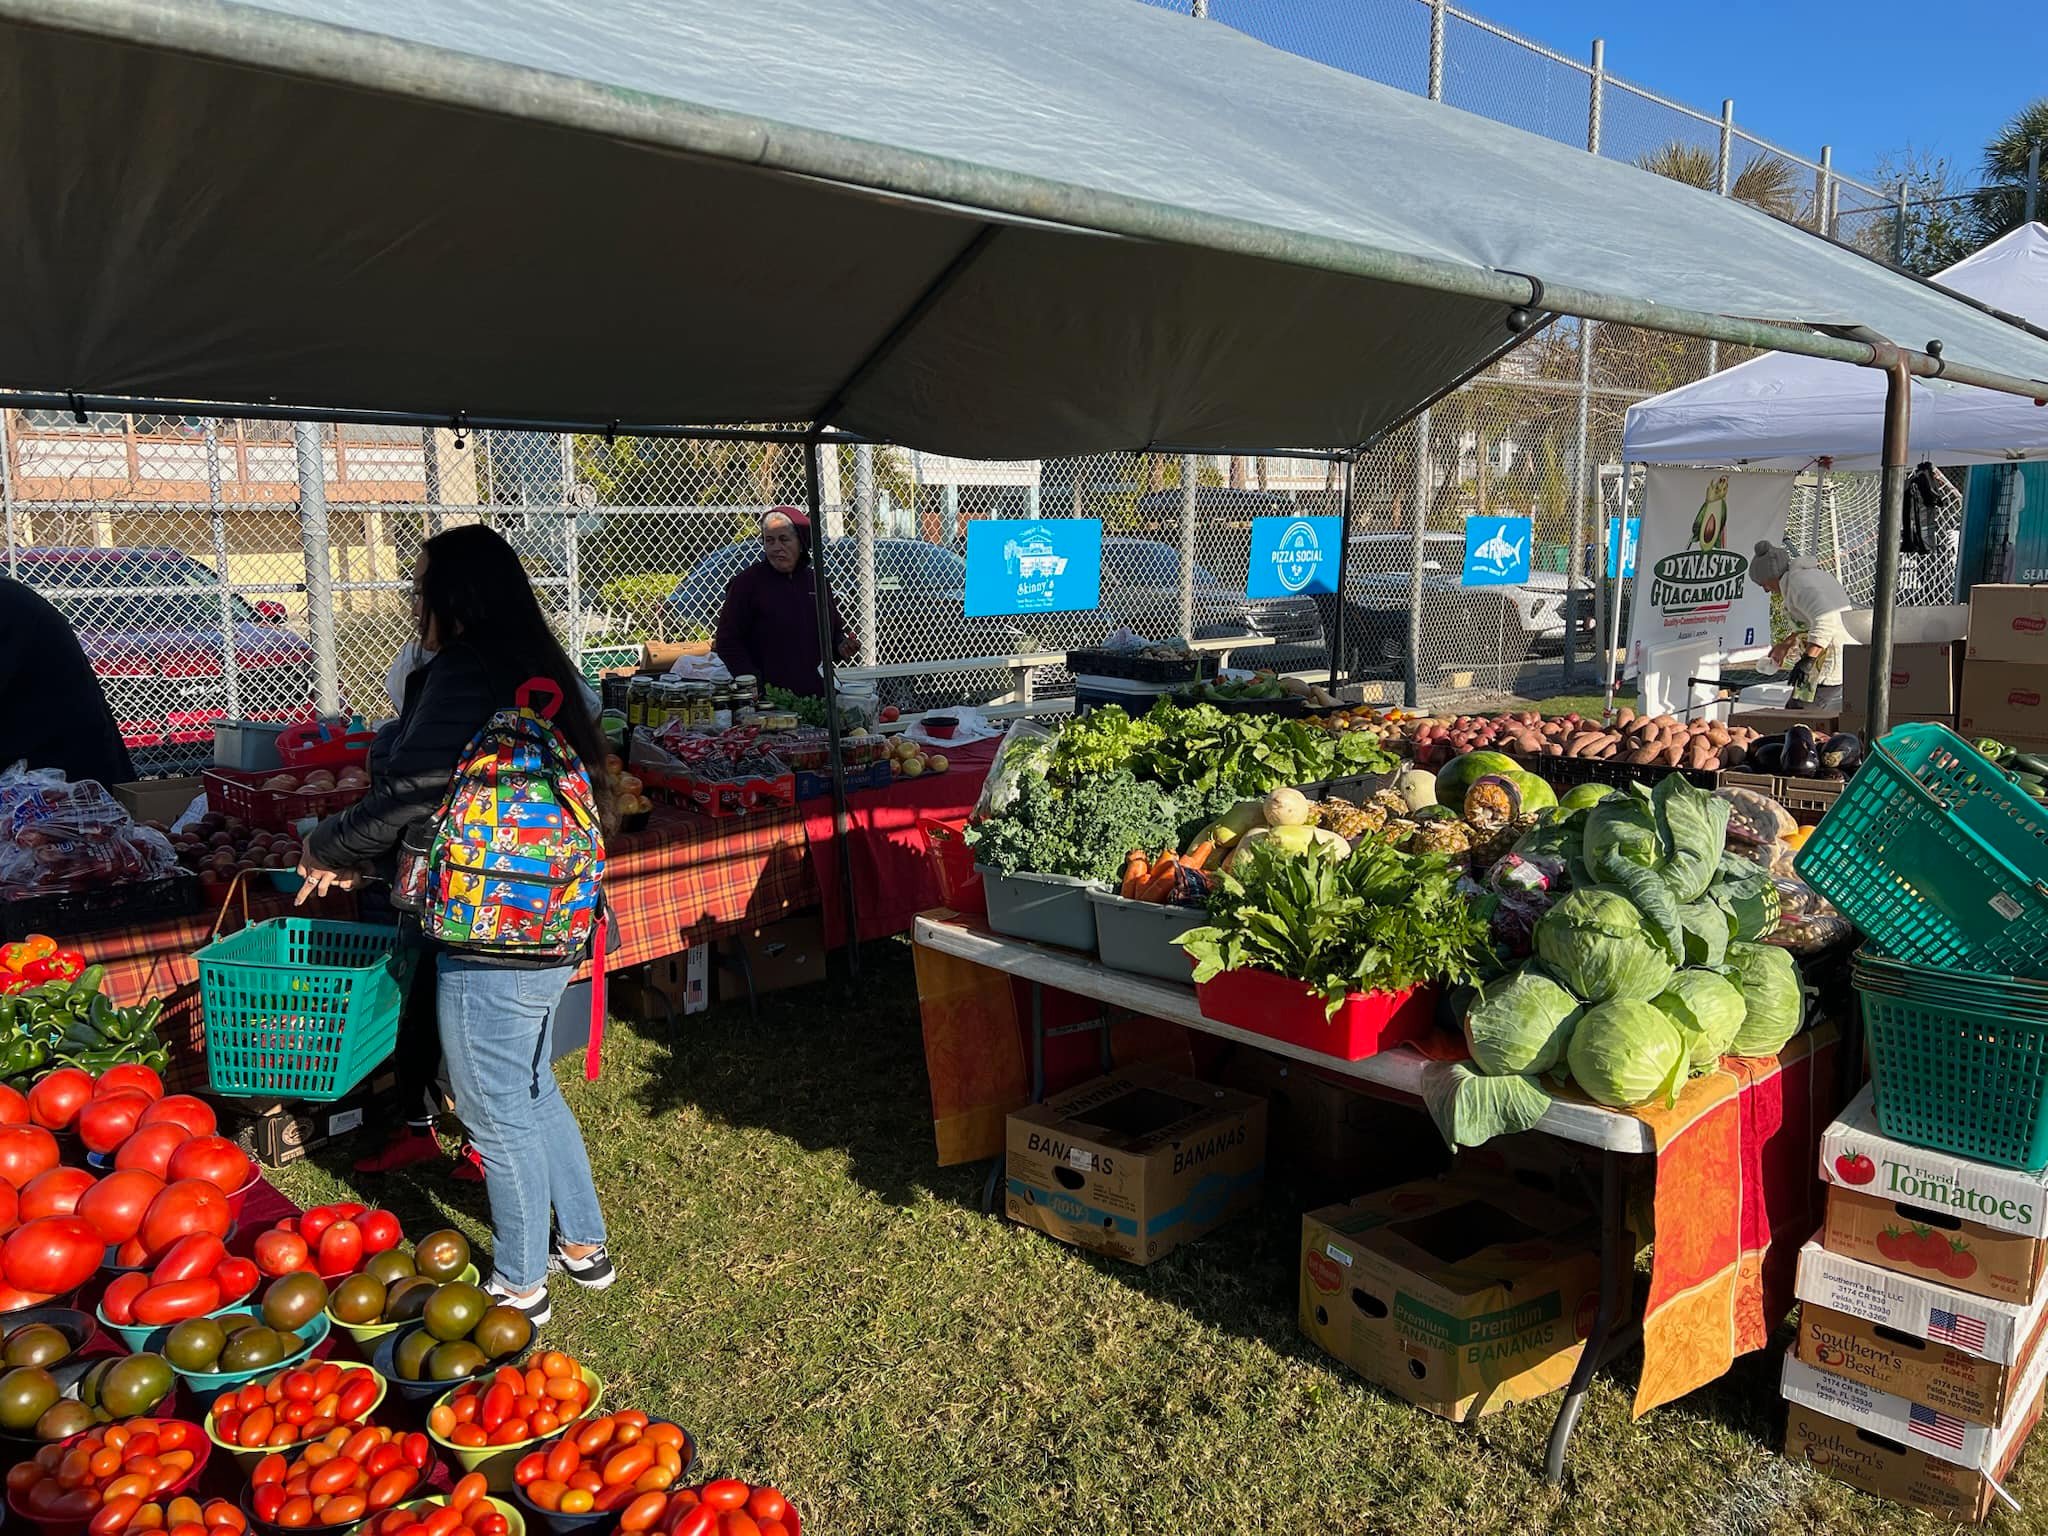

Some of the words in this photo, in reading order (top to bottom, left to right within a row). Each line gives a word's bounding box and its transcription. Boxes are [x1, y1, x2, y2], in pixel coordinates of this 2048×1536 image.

[1271, 550, 1295, 564] PIZZA
[1295, 549, 1324, 563] SOCIAL
[1663, 554, 1740, 580] DYNASTY
[1017, 578, 1055, 596] Skinny's
[1650, 573, 1745, 607] GUACAMOLE
[1028, 1133, 1114, 1175] BANAAS
[1173, 1125, 1248, 1176] BANANAS
[1914, 1168, 1960, 1186] Florida
[1881, 1159, 2033, 1225] Tomatoes
[1822, 1272, 1865, 1290] Southern's
[1866, 1285, 1886, 1299] Best,
[1887, 1293, 1904, 1303] LLC
[1838, 1285, 1857, 1296] 3174
[1858, 1290, 1870, 1300] CR
[1832, 1301, 1851, 1313] (239)
[1852, 1307, 1887, 1323] 707-3260
[1856, 1299, 1866, 1308] FL
[1868, 1303, 1891, 1316] 33930
[1395, 1303, 1449, 1338] Premium
[1469, 1305, 1543, 1338] Premium
[1467, 1326, 1554, 1364] BANANAS
[1810, 1323, 1903, 1370] Southern's
[1845, 1353, 1878, 1378] Best
[1940, 1365, 1961, 1377] 11.34
[1943, 1358, 1959, 1367] NET
[1822, 1376, 1840, 1387] 3174
[1841, 1383, 1853, 1392] CR
[1933, 1378, 1951, 1389] 3174
[1952, 1385, 1964, 1395] CR
[1817, 1391, 1835, 1403] (239)
[1839, 1391, 1849, 1399] FL
[1850, 1395, 1873, 1408] 33930
[1950, 1391, 1960, 1401] FL
[1797, 1422, 1885, 1471] Southern's
[1830, 1454, 1860, 1477] Best
